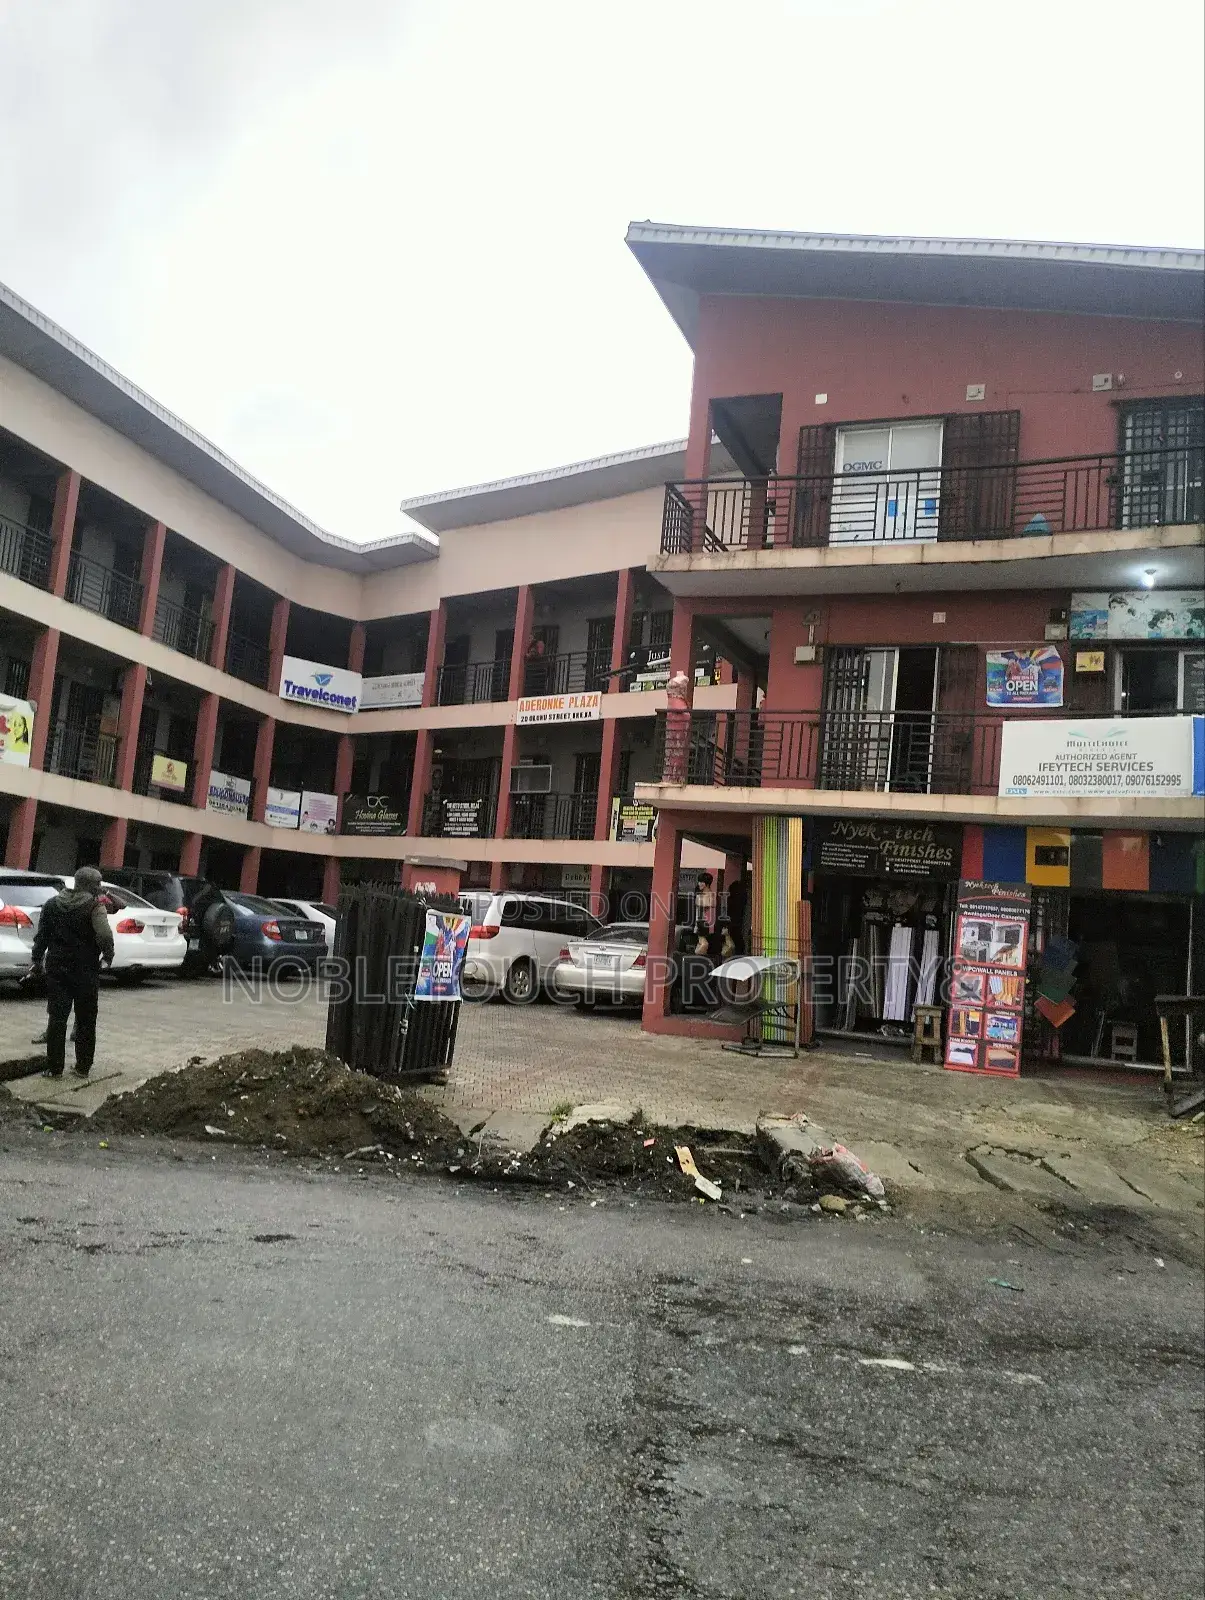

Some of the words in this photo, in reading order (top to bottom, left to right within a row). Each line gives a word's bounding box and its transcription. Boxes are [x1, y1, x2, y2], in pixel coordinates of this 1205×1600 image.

[1006, 680, 1038, 691] OPEN
[284, 680, 358, 707] Travelconet
[519, 697, 565, 712] ADERONKE
[568, 694, 599, 709] PLAZA
[548, 712, 571, 720] STREET
[1055, 753, 1108, 761] AUTHORIZED
[1109, 752, 1138, 760] AGENT
[1038, 762, 1093, 772] IFEYTECH
[1096, 761, 1154, 772] SERVICES
[1012, 774, 1067, 786] 08062491101,
[1068, 774, 1124, 787] 08032380017,
[1125, 774, 1182, 786] 09076152995
[895, 824, 934, 842] tech
[880, 840, 953, 861] Finishes
[432, 961, 453, 978] OPEN
[994, 967, 1018, 977] PANELS
